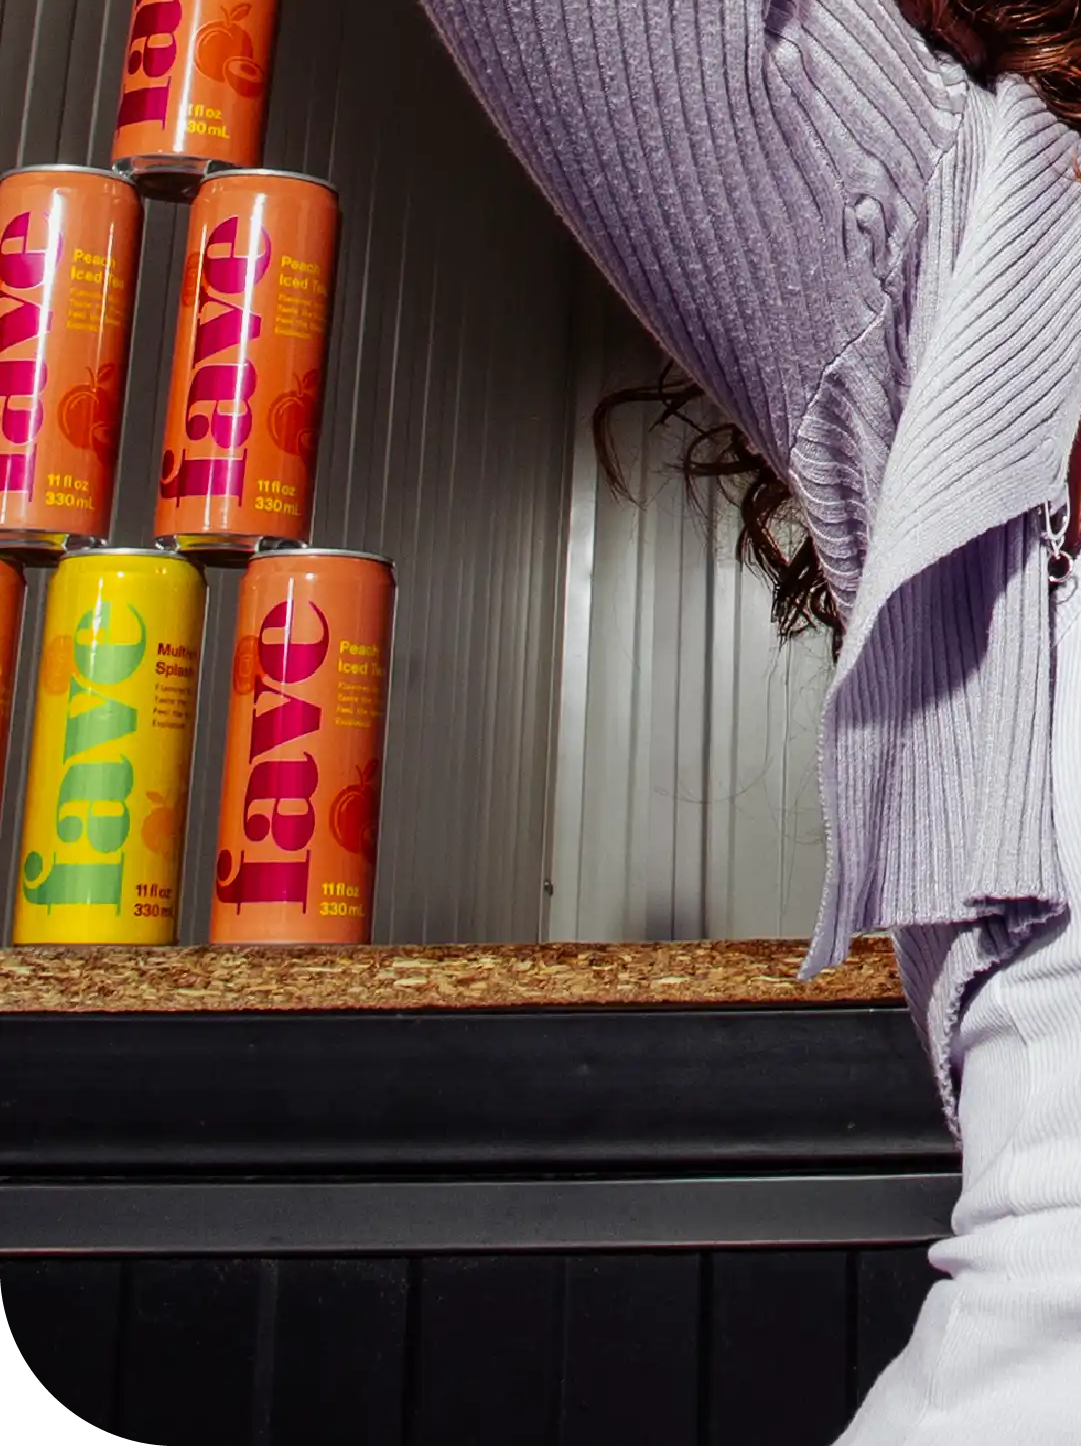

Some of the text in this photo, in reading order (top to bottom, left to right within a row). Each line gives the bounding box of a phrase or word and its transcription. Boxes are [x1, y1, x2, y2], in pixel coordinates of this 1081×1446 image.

[207, 125, 230, 139] mL
[281, 255, 320, 275] Peach
[70, 265, 103, 284] Iced
[280, 273, 309, 290] Iced
[160, 216, 271, 507] fave
[45, 491, 75, 506] 330
[254, 495, 282, 513] 330
[338, 657, 368, 676] Iced
[22, 600, 147, 916] fave
[217, 600, 330, 915] fave
[134, 903, 159, 917] 330
[319, 901, 348, 916] 330
